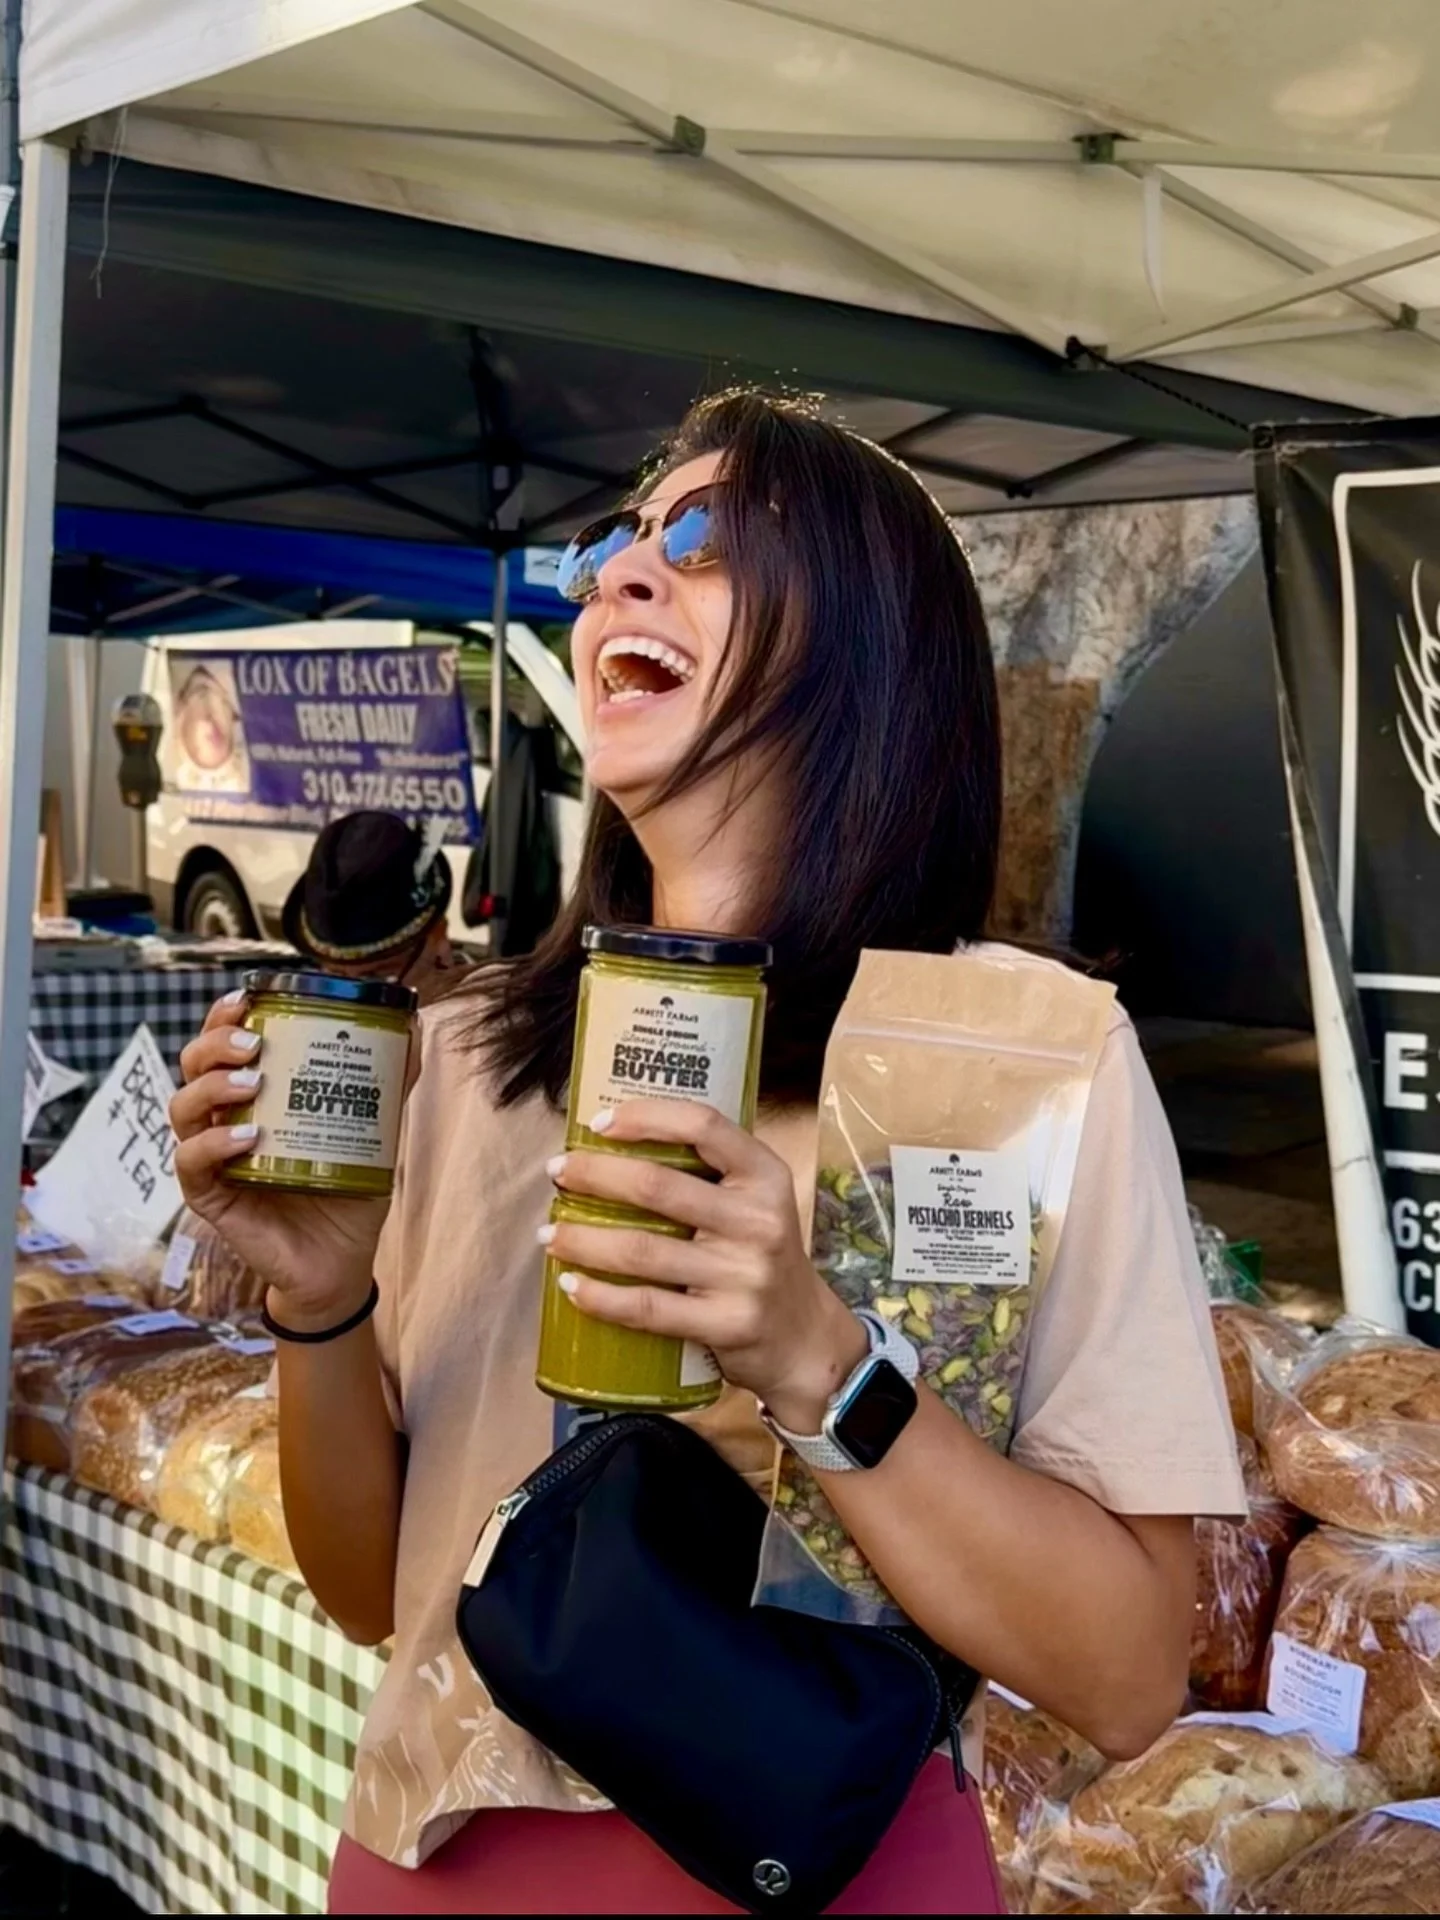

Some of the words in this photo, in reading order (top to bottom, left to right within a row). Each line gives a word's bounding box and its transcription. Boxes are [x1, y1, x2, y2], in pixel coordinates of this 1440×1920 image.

[238, 655, 292, 696] LOX
[294, 656, 333, 696] OF
[338, 652, 457, 697] BAGELS
[296, 703, 360, 743] FRESH
[360, 703, 418, 743] DAILY
[614, 1043, 711, 1070] PISTACHIO
[1384, 1031, 1440, 1111] E
[612, 1058, 709, 1089] BUTTER
[290, 1077, 381, 1100] PISTACHIO
[288, 1093, 379, 1119] BUTTER
[942, 1191, 973, 1208] Raw
[908, 1205, 961, 1228] PISTACHIO
[962, 1209, 1014, 1230] KERNELS
[1403, 1259, 1440, 1315] C
